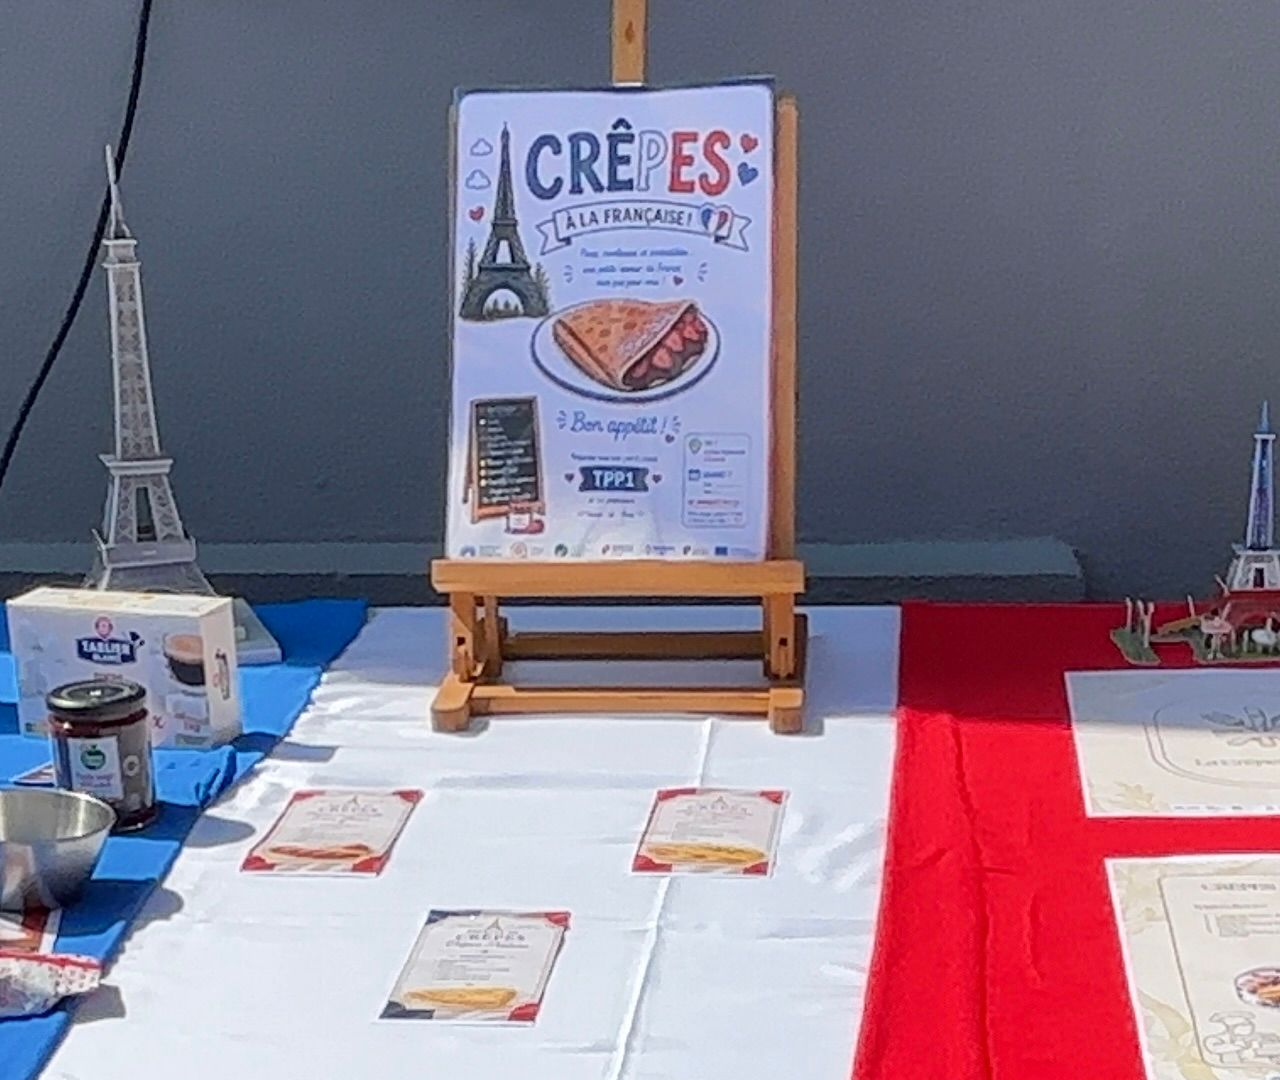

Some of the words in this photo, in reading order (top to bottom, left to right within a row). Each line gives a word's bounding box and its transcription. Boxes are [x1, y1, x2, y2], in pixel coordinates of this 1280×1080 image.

[525, 117, 731, 200] CRÊPES
[579, 211, 599, 227] LA
[569, 410, 604, 433] Bon
[607, 415, 659, 441] appétit
[591, 469, 635, 488] TPP1
